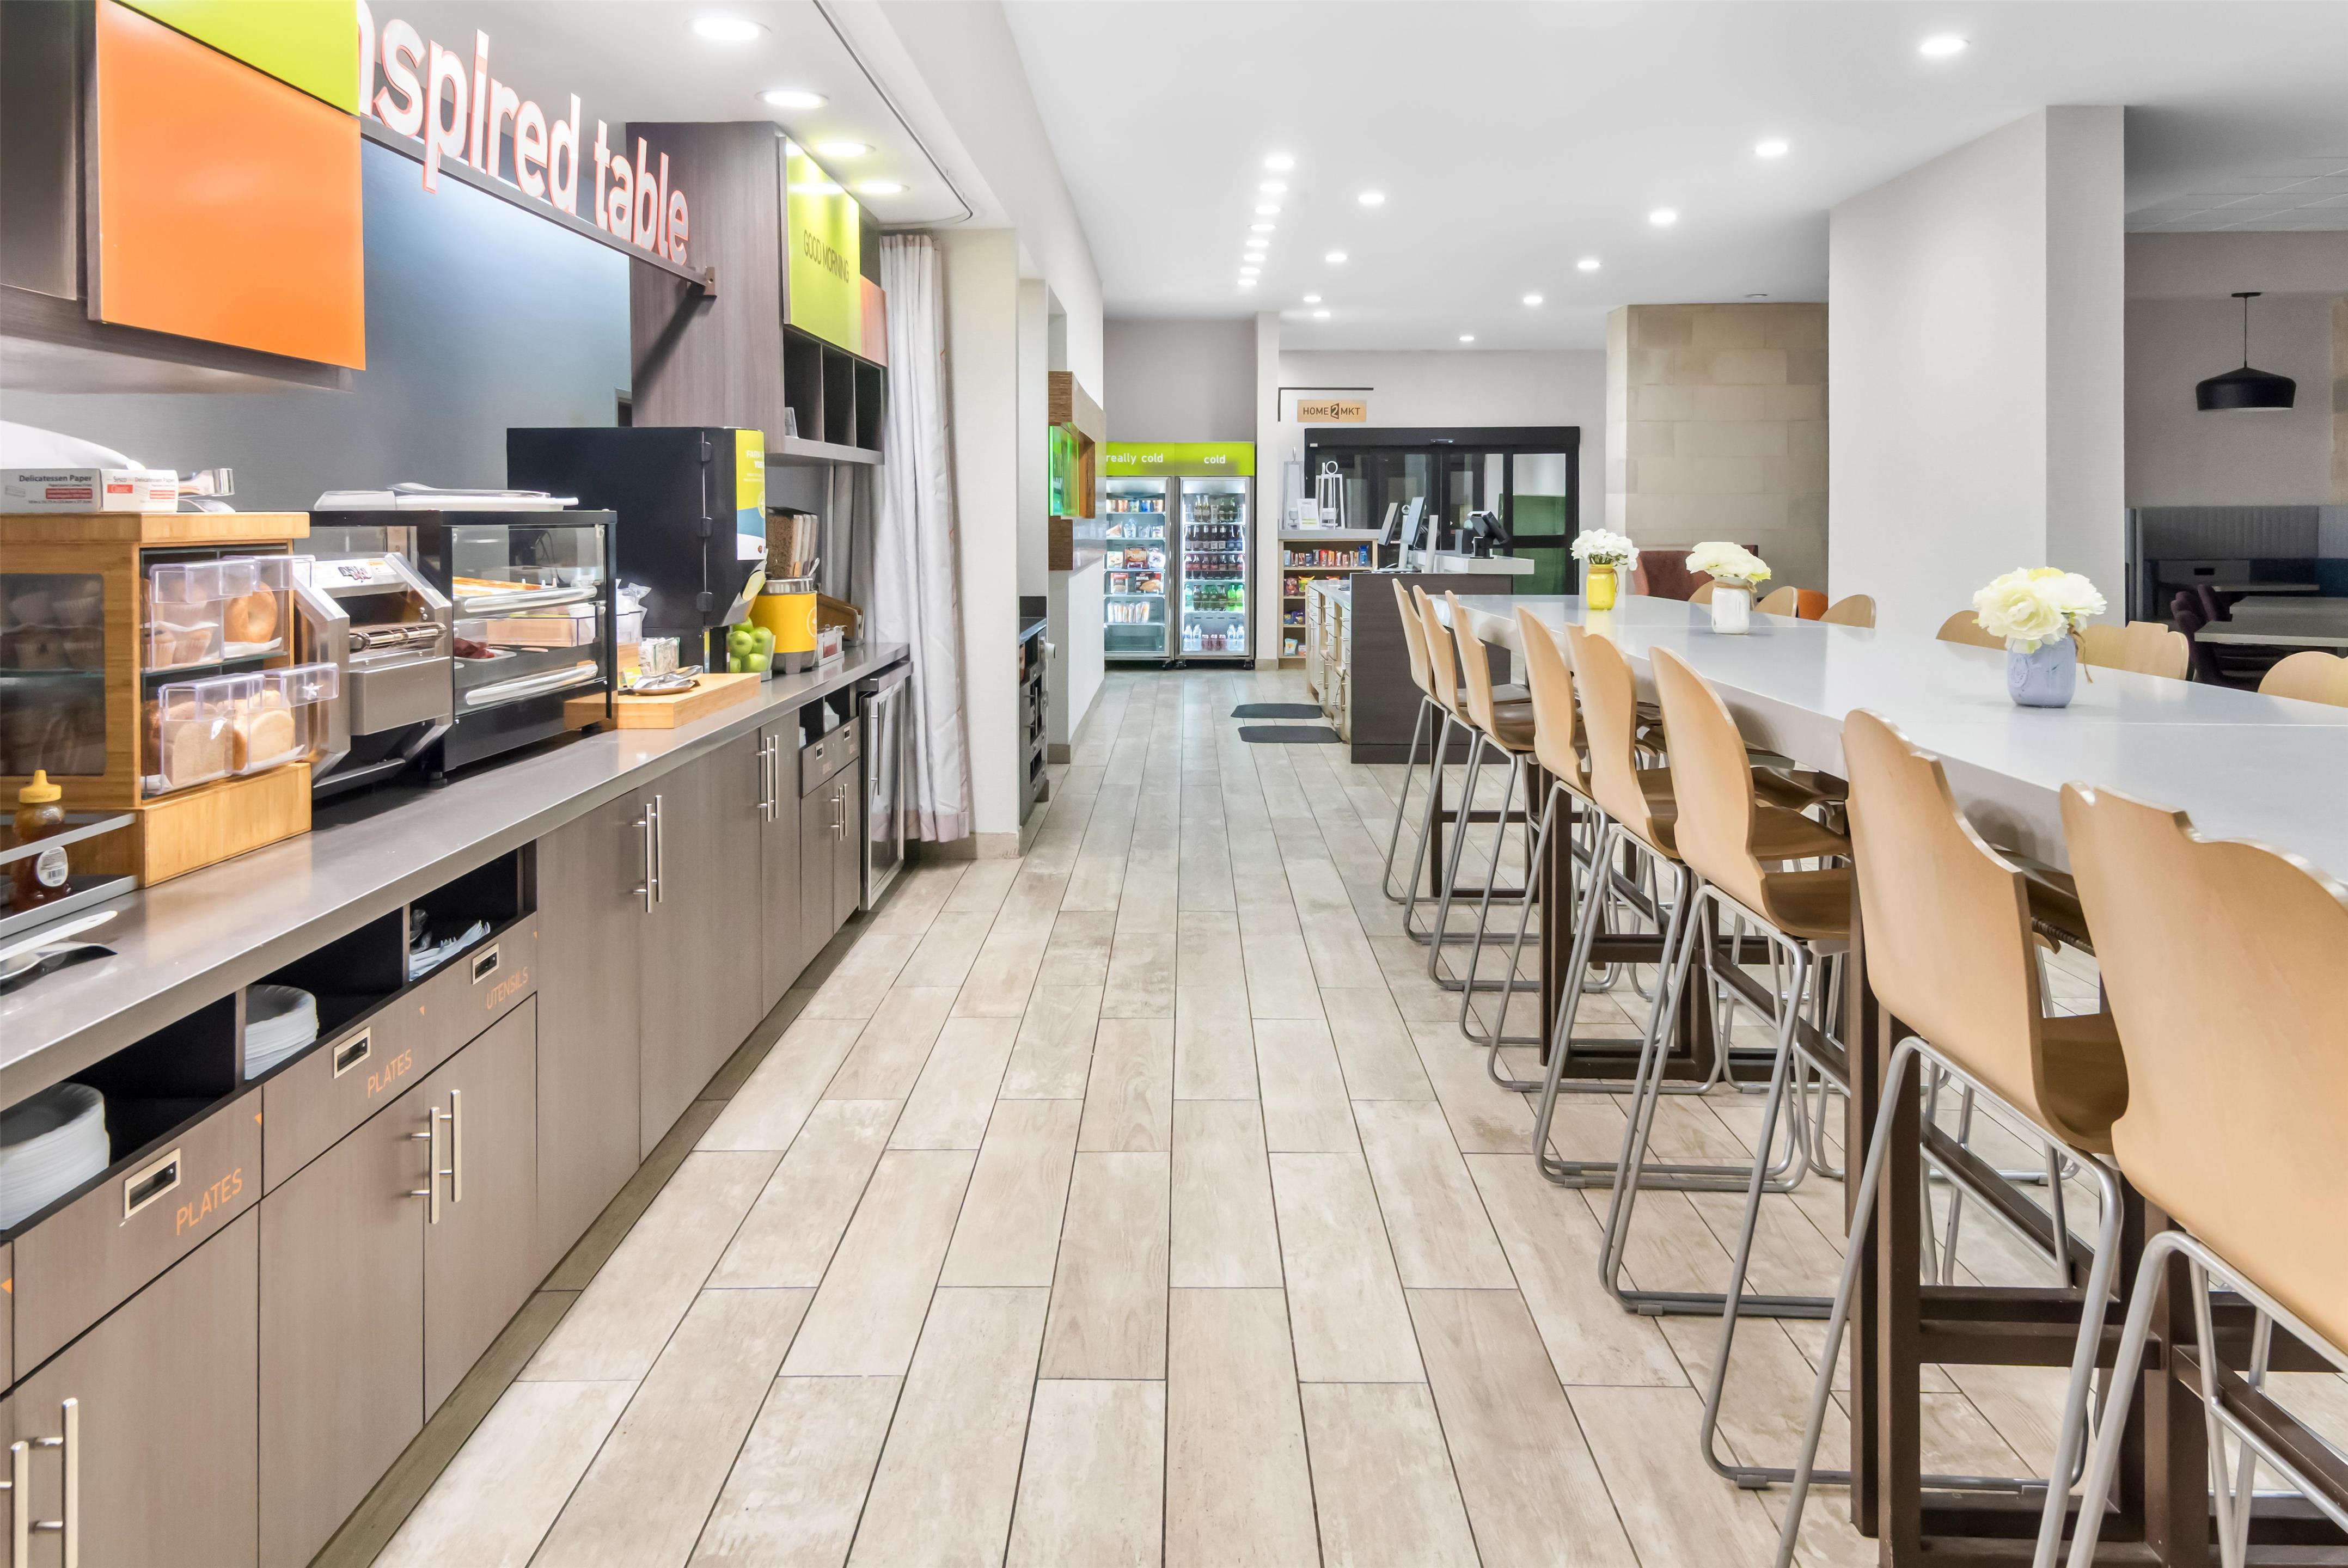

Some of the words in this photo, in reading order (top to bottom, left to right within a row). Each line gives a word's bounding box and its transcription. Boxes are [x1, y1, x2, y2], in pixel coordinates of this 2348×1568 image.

[593, 119, 689, 266] table
[803, 229, 822, 265] GOOD
[822, 244, 850, 284] MORNING
[69, 474, 92, 483] Paper
[113, 476, 127, 484] Sysco
[1106, 452, 1137, 465] really
[1141, 452, 1164, 463] cold
[1203, 454, 1226, 464] cold
[487, 966, 529, 1010] UTENSILS
[367, 1049, 412, 1099] PLATES
[176, 1167, 242, 1236] PLATES
